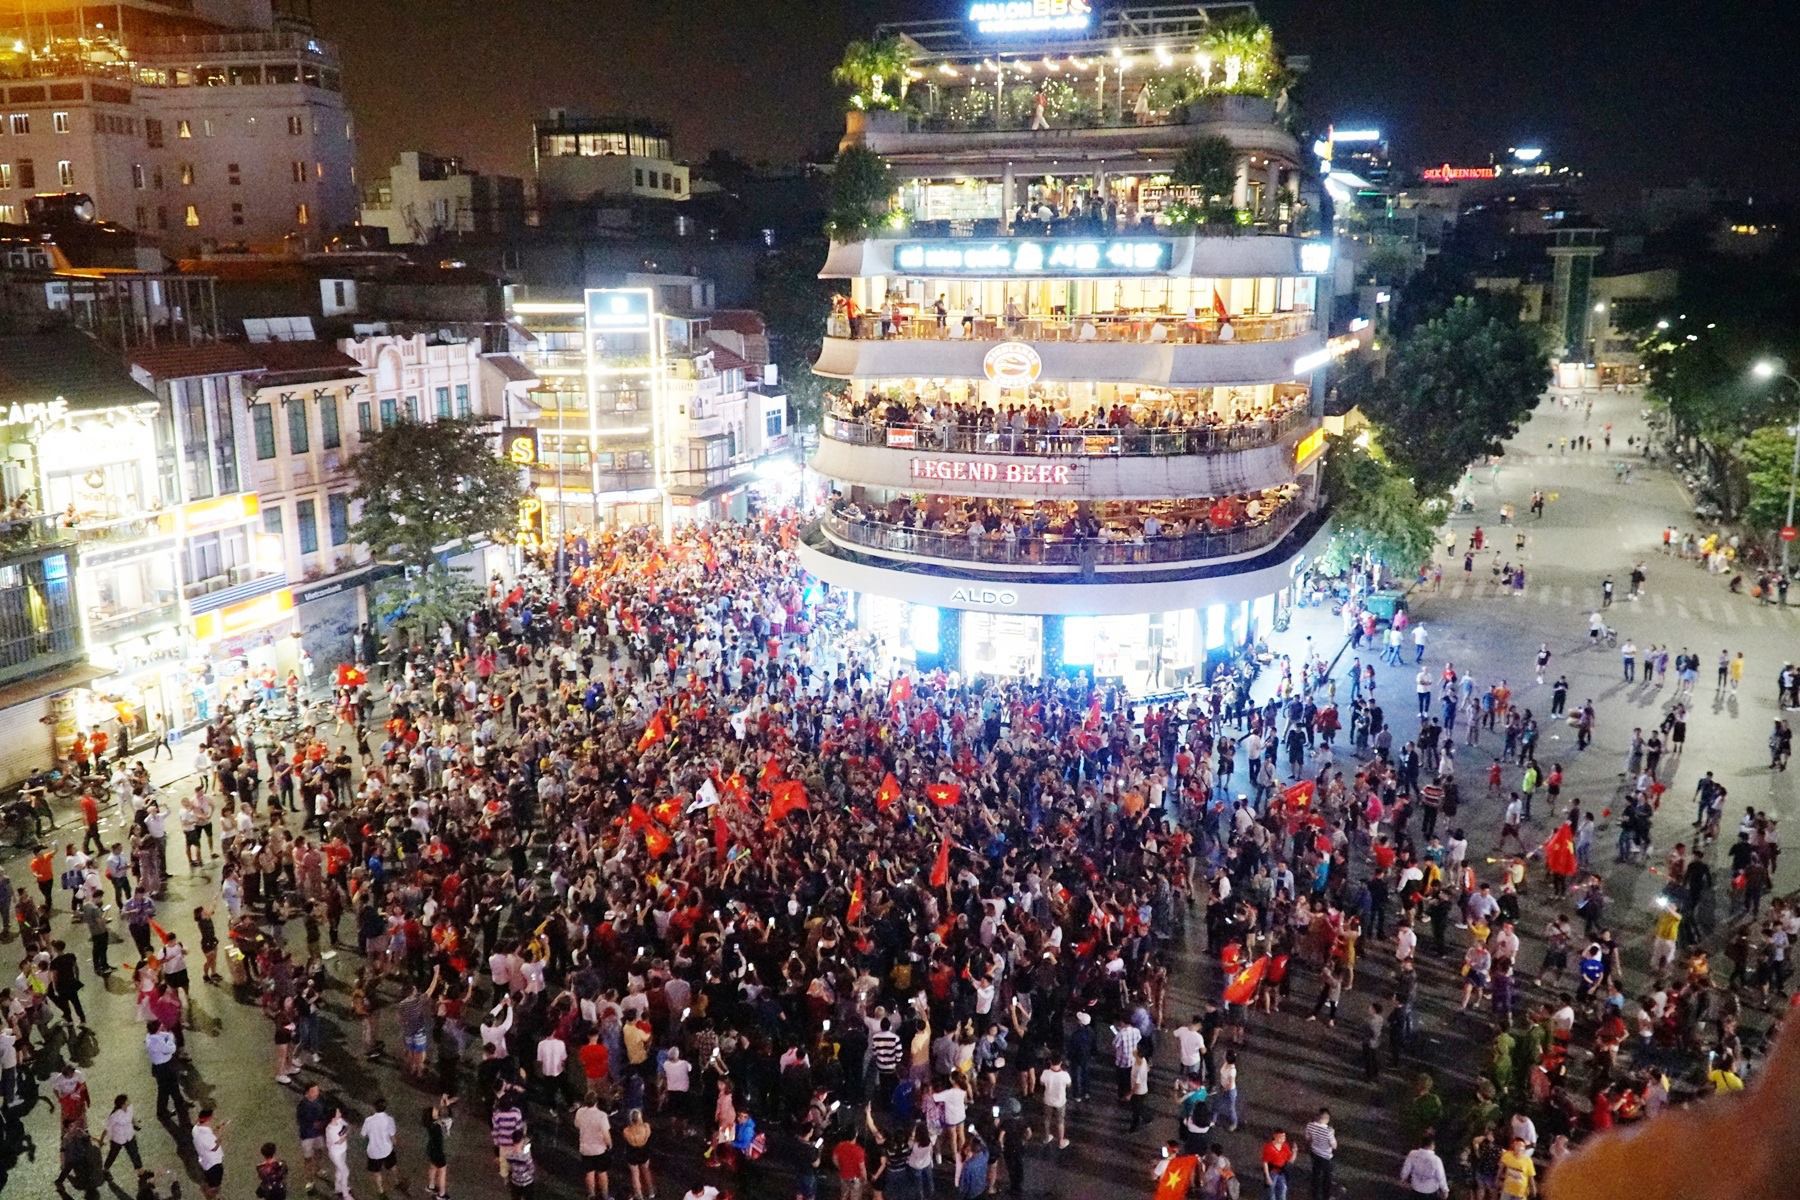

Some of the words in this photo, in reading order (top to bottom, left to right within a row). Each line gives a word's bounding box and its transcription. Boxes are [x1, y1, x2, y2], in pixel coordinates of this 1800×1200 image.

[1441, 163, 1469, 181] QUEEN
[1469, 167, 1493, 178] HOTEL
[913, 458, 997, 481] LEGEND
[1006, 464, 1069, 484] BEER
[951, 589, 1015, 605] ALDO
